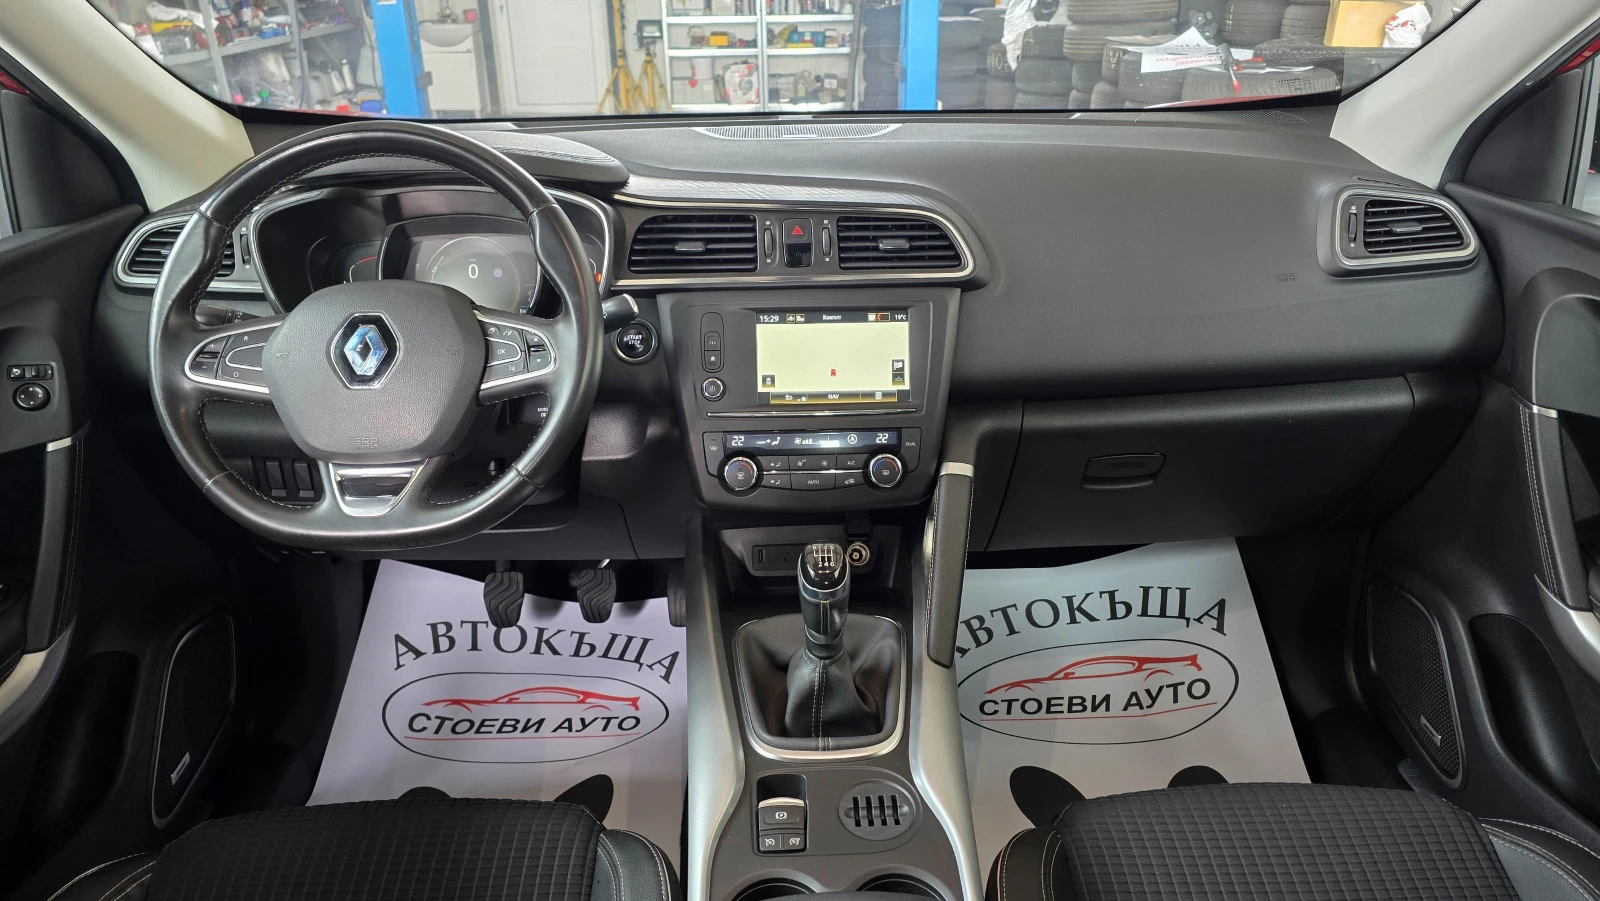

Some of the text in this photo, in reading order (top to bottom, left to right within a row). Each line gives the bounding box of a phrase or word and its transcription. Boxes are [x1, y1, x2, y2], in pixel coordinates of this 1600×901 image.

[468, 263, 479, 279] 0
[731, 436, 745, 446] 22
[876, 433, 889, 443] 22
[392, 620, 681, 684] АВТОКЪЩА
[978, 677, 1211, 716] СТОЕВИ АУТО
[408, 711, 642, 736] СТОЕВИ АУТО
